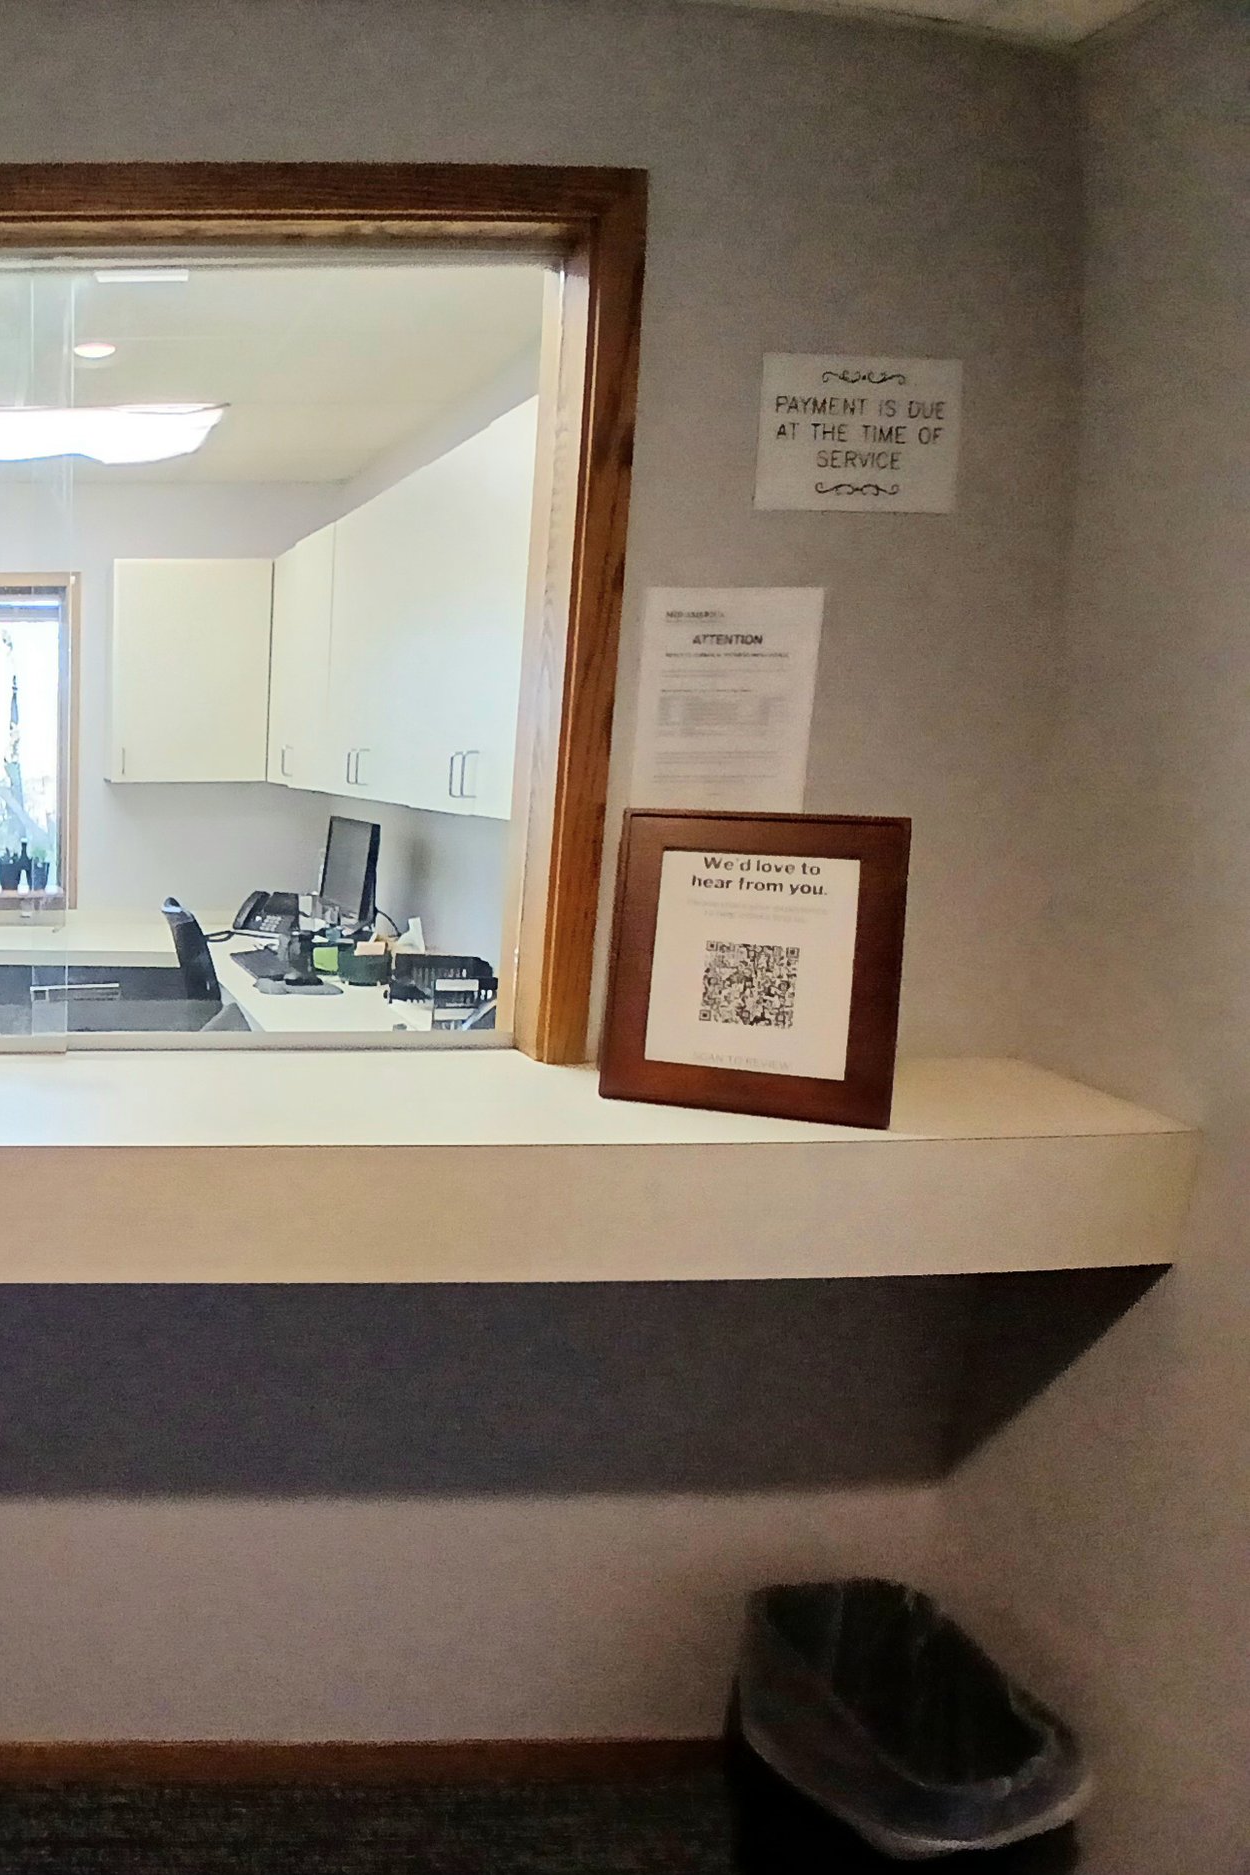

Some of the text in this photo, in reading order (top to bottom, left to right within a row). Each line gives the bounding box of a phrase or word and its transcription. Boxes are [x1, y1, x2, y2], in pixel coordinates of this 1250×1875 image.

[775, 395, 946, 420] PAYMENT IS DUE
[776, 422, 945, 445] AT THE TIME OF
[816, 450, 902, 470] SERVICE
[692, 633, 764, 646] ATTENTION
[703, 856, 821, 876] We'd love to
[691, 874, 828, 896] hear from you.
